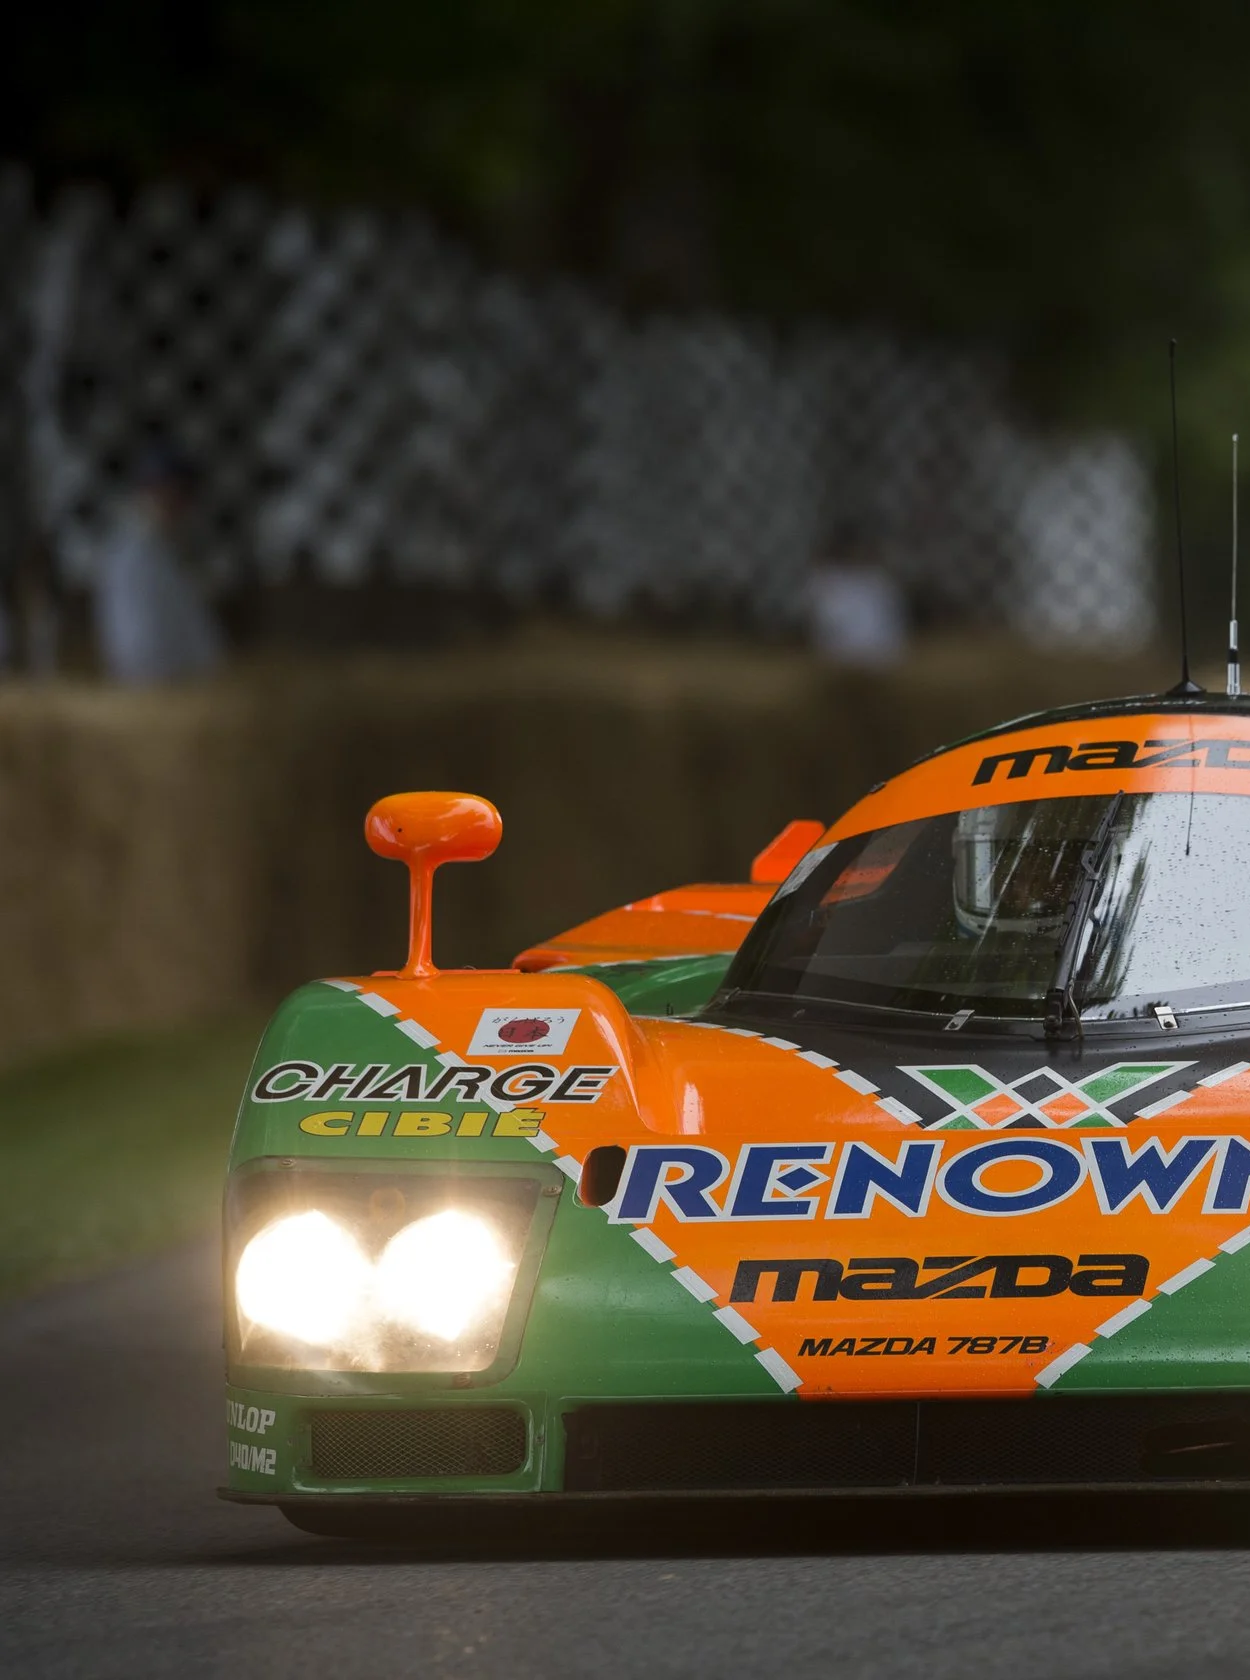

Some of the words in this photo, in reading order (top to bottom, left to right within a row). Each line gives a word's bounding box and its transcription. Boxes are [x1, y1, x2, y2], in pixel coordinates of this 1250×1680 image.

[251, 1060, 620, 1103] CHARGE
[299, 1108, 546, 1137] CIBIÉ
[731, 1254, 1149, 1302] mazda
[798, 1337, 936, 1356] MAZDA
[947, 1336, 1049, 1355] 787B
